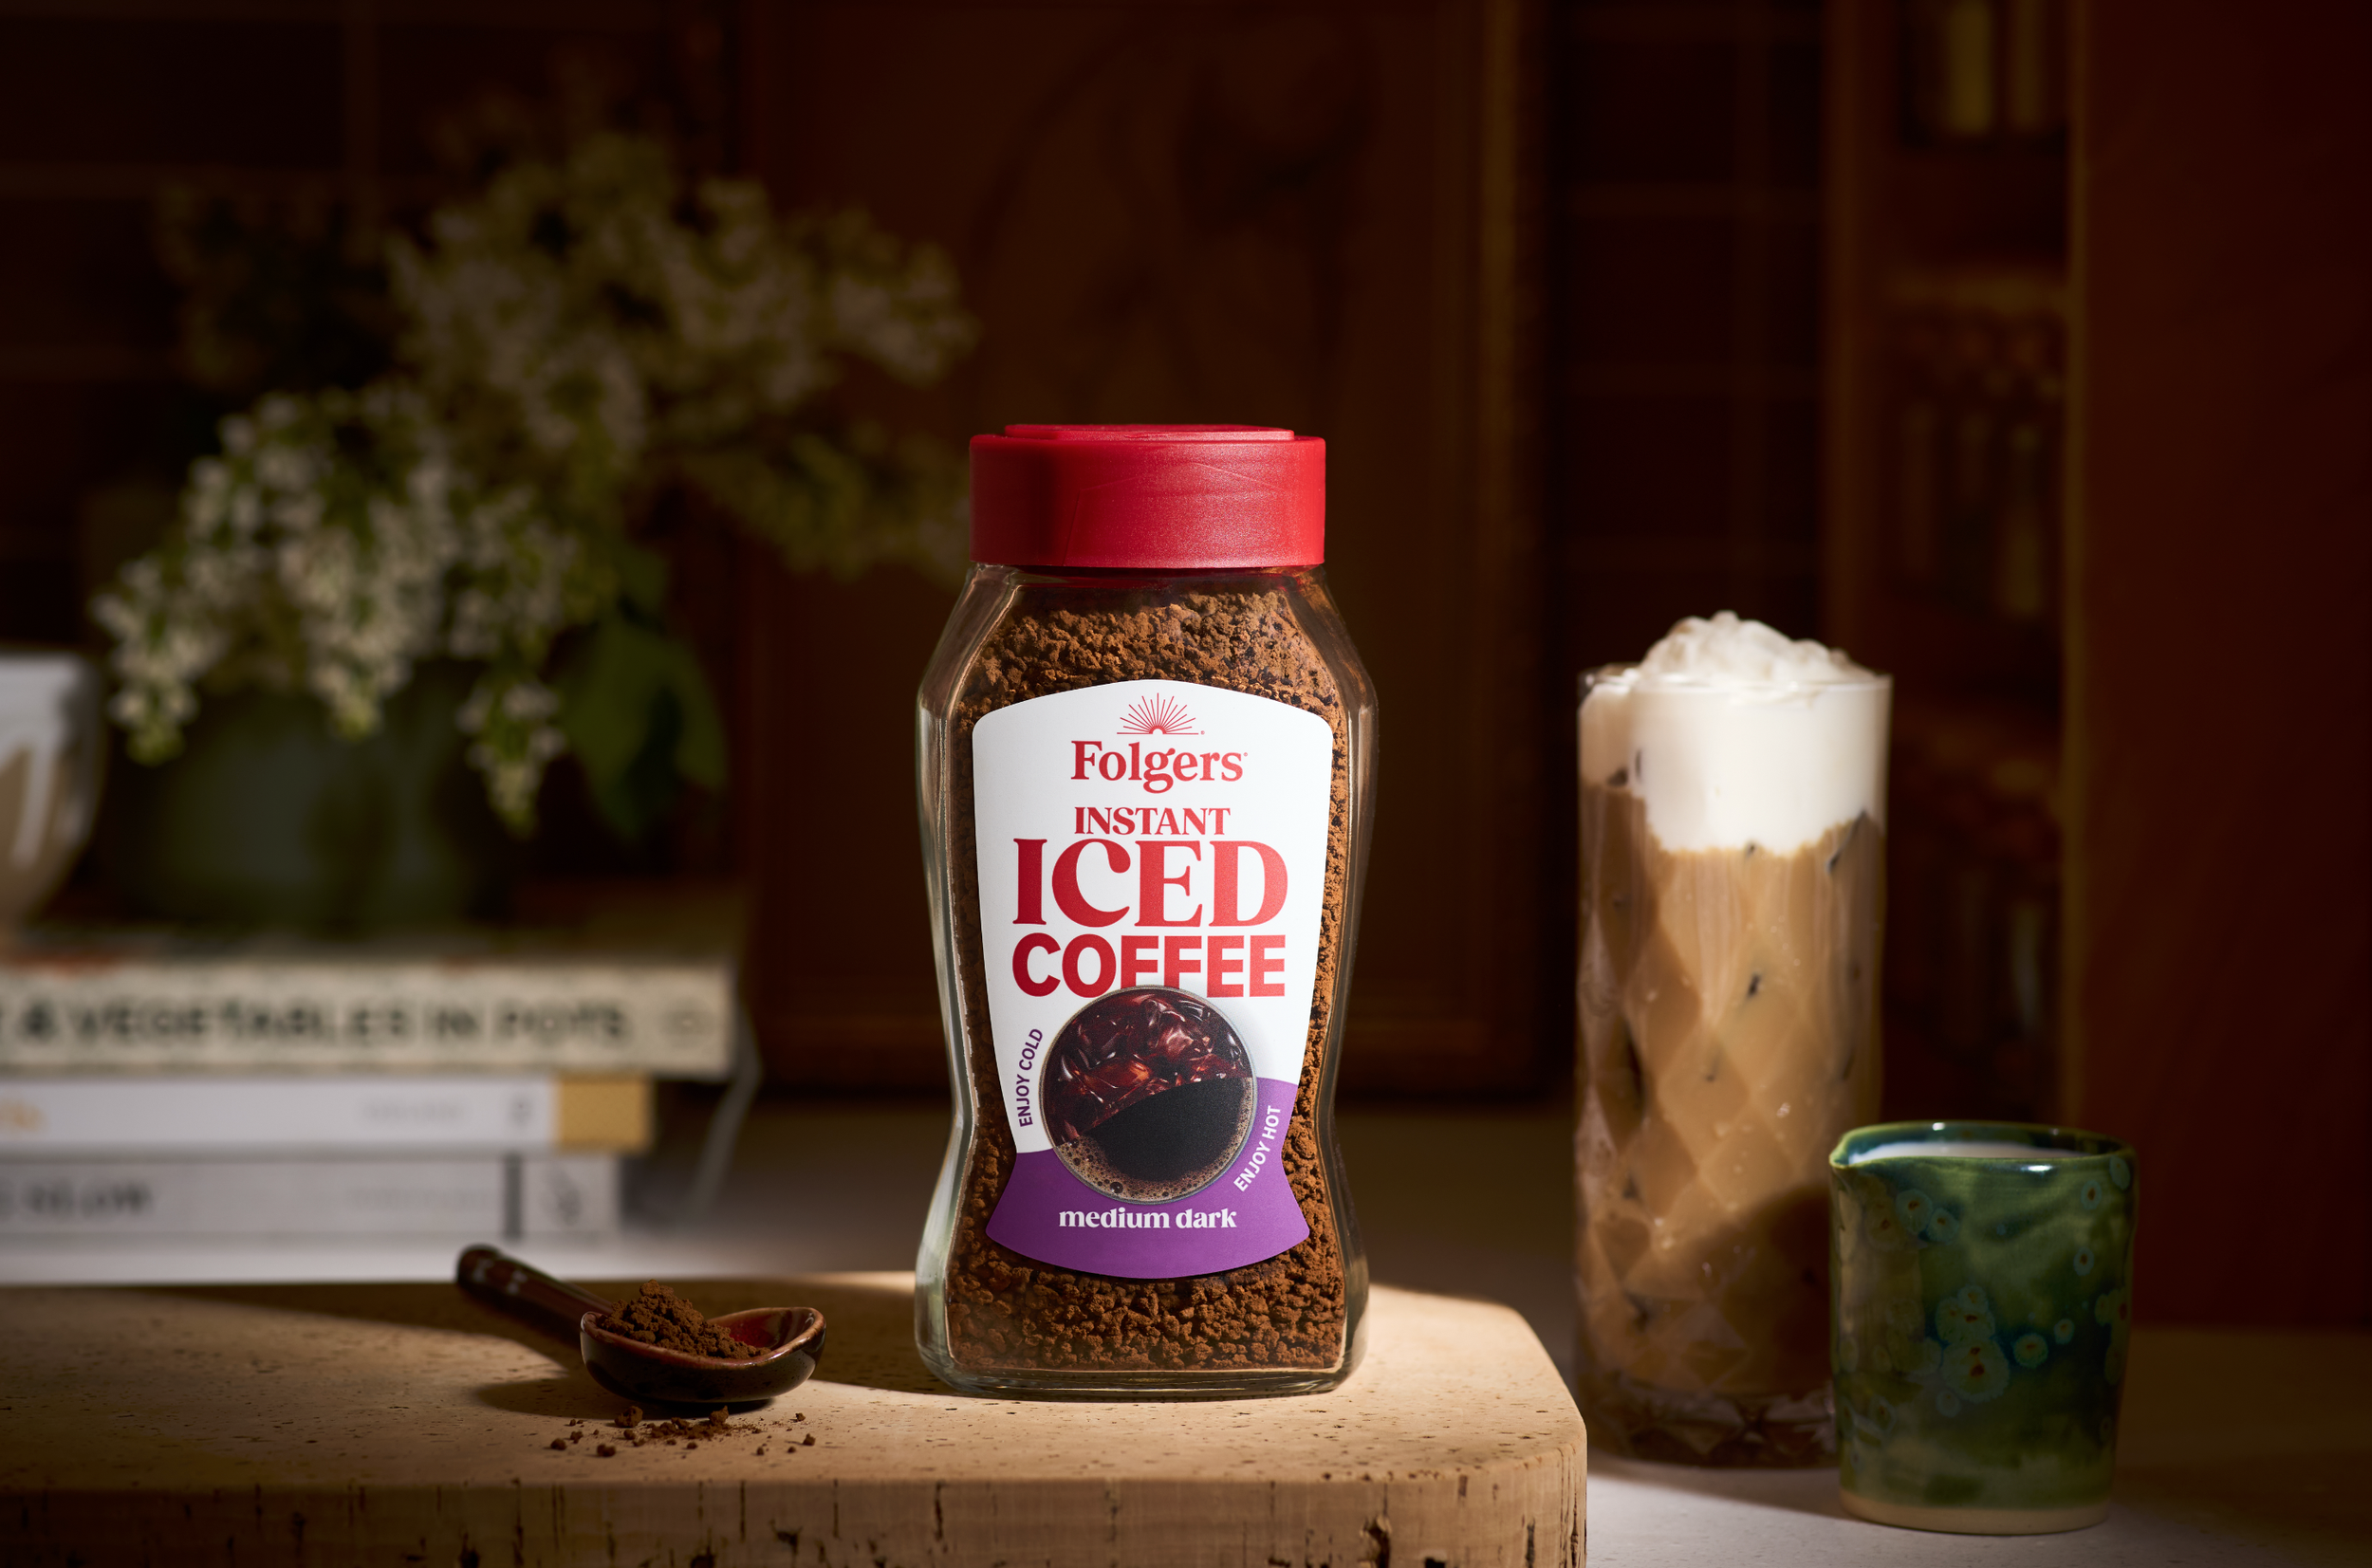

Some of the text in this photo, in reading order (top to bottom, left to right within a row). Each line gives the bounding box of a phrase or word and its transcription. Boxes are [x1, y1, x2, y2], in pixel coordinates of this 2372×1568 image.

[1070, 740, 1243, 793] Folgers
[1074, 806, 1231, 835] INSTANT
[1012, 838, 1288, 927] ICED
[1012, 932, 1286, 998] COFFEE
[1017, 1028, 1043, 1127] ENJOY COLD
[1233, 1105, 1282, 1192] ENJOY HOT
[1058, 1207, 1237, 1228] medium dark
